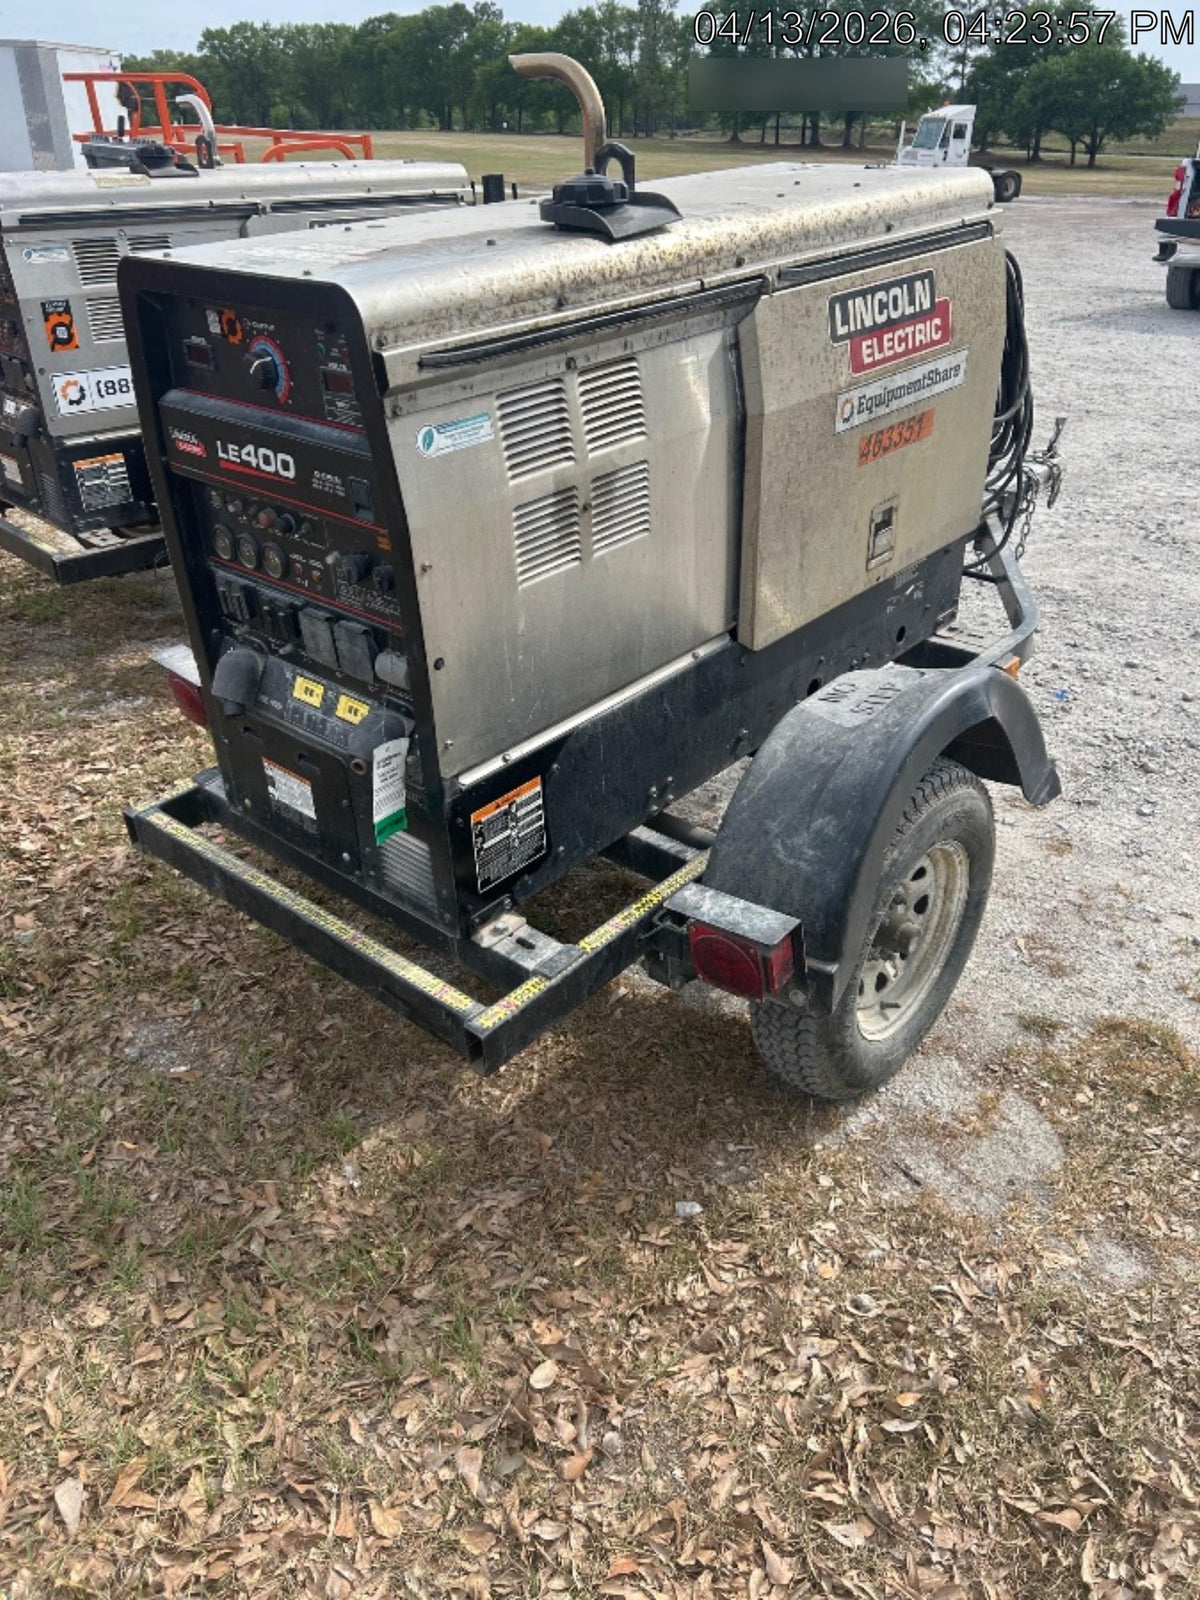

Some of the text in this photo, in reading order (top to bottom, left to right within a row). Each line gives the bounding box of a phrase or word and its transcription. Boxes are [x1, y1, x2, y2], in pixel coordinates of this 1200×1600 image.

[835, 278, 931, 336] LINCOLN
[861, 317, 942, 365] ELECTRIC
[856, 362, 962, 415] EquipmentShare
[216, 440, 296, 479] LE400
